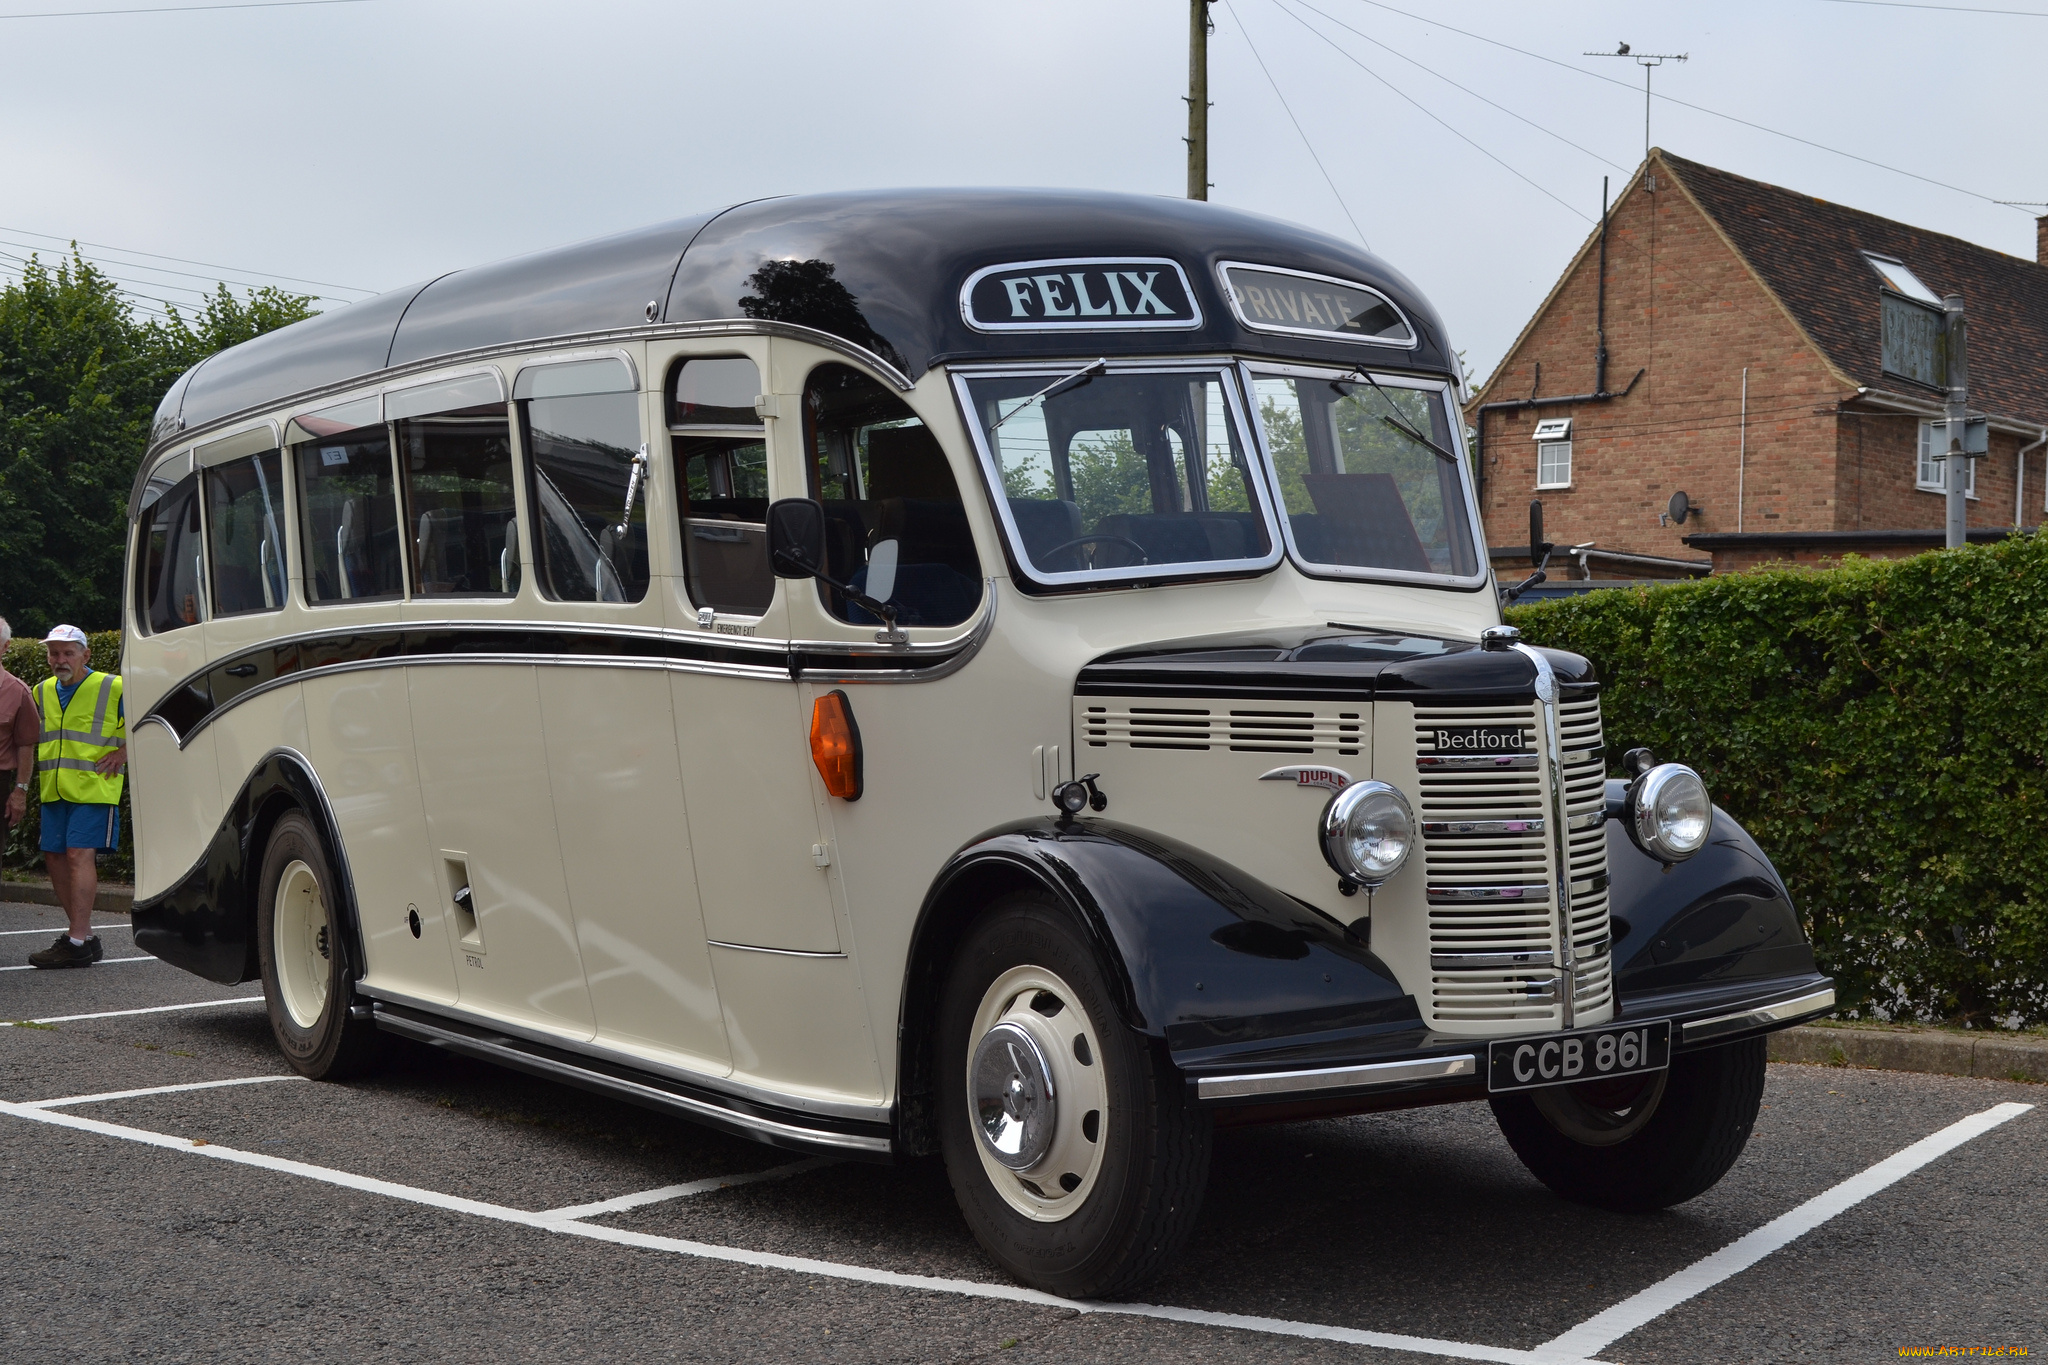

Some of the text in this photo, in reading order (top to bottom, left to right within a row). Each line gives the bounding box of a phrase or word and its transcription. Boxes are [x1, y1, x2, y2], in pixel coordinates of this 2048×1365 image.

[1000, 271, 1177, 318] FELIX
[717, 624, 756, 637] EMERGENCY EXIT
[1436, 729, 1523, 749] Bedford
[1298, 770, 1347, 788] DUPLE
[466, 954, 484, 969] PETROL
[1513, 1029, 1648, 1082] CCB 861
